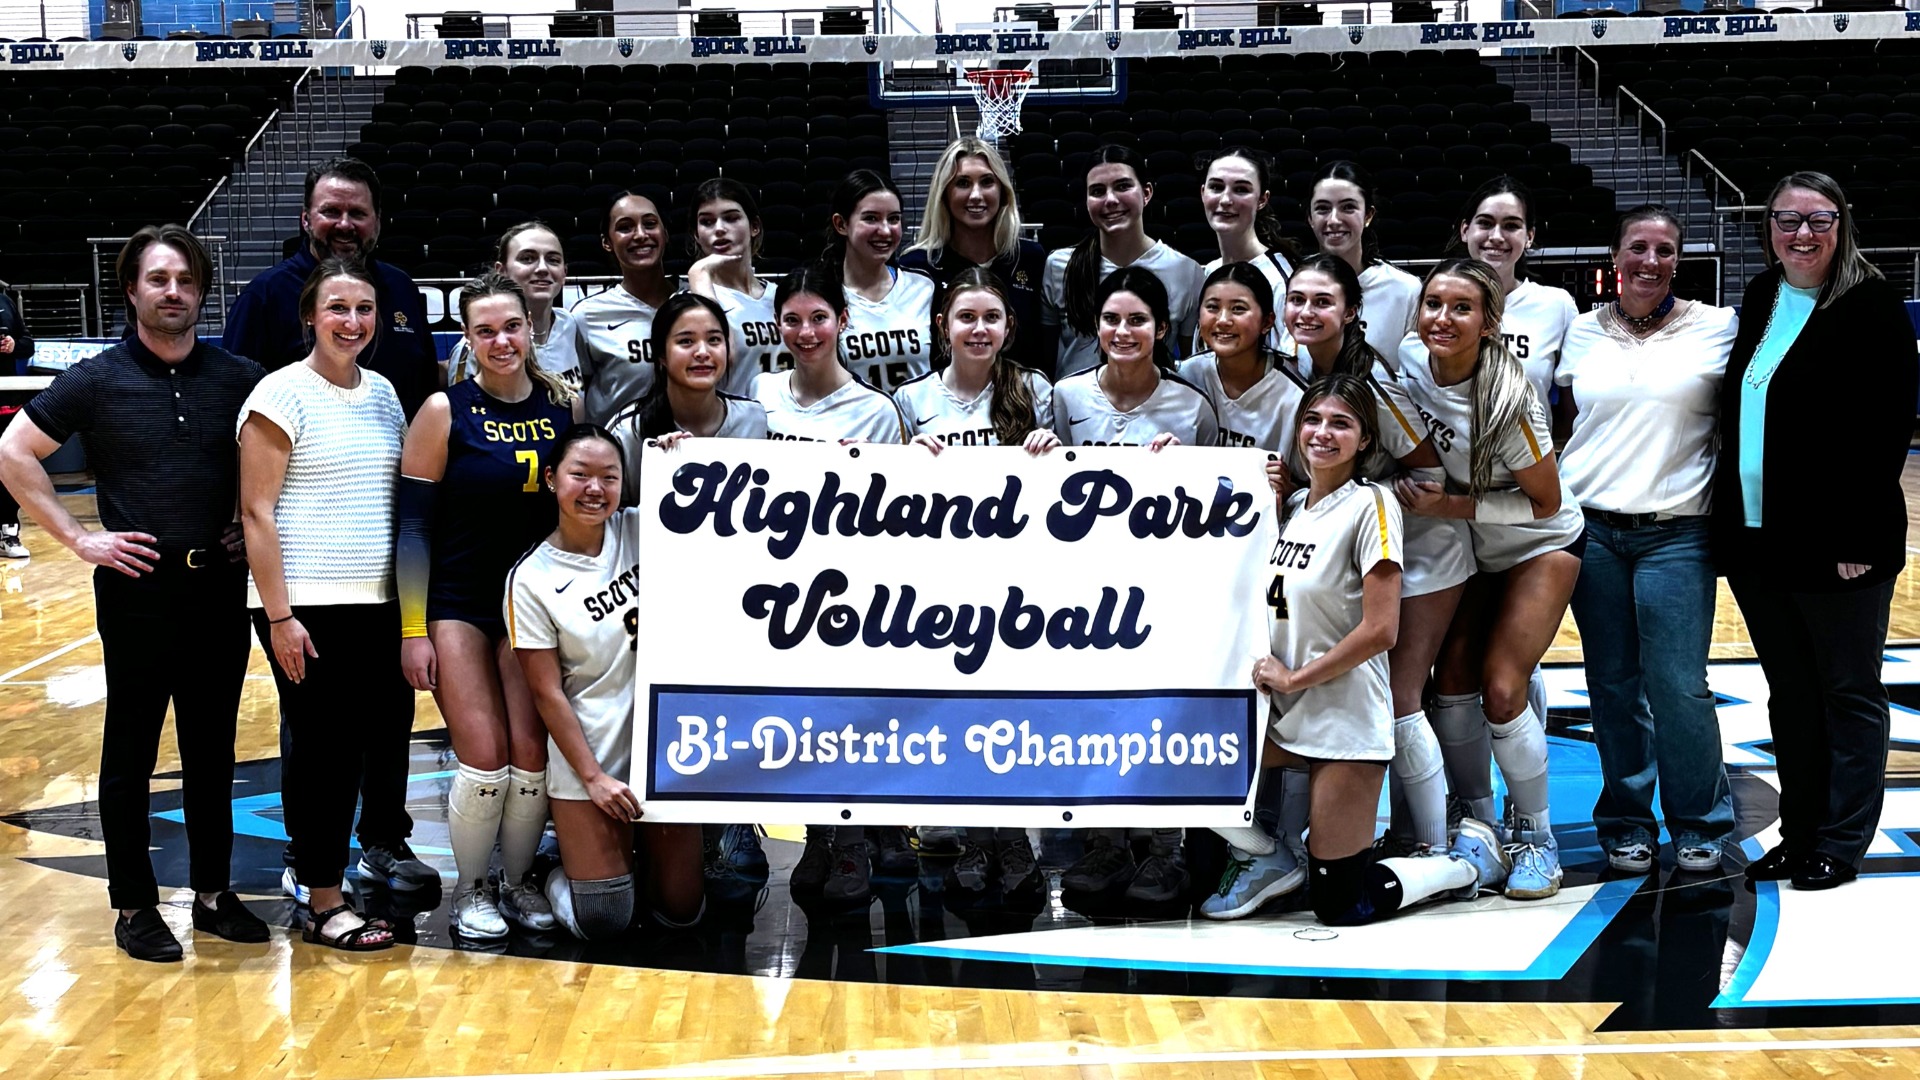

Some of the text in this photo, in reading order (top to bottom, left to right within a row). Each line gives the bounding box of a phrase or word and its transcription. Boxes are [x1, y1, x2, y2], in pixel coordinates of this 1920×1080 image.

[1420, 22, 1534, 44] ROCK HILL
[1664, 16, 1777, 38] ROCK HILL
[444, 39, 561, 59] ROCK HILL
[691, 37, 806, 57] ROCK HILL
[935, 34, 1049, 54] ROCK HILL
[1178, 28, 1291, 50] ROCK HILL
[8, 44, 64, 64] HILL
[195, 41, 313, 62] ROCK HILL
[846, 329, 920, 360] SCOTS
[483, 417, 556, 443] SCOTS
[514, 449, 540, 493] 7
[658, 460, 1261, 560] Highland Park
[742, 568, 1152, 676] Volleyball
[666, 715, 1241, 777] Bi-District Champions
